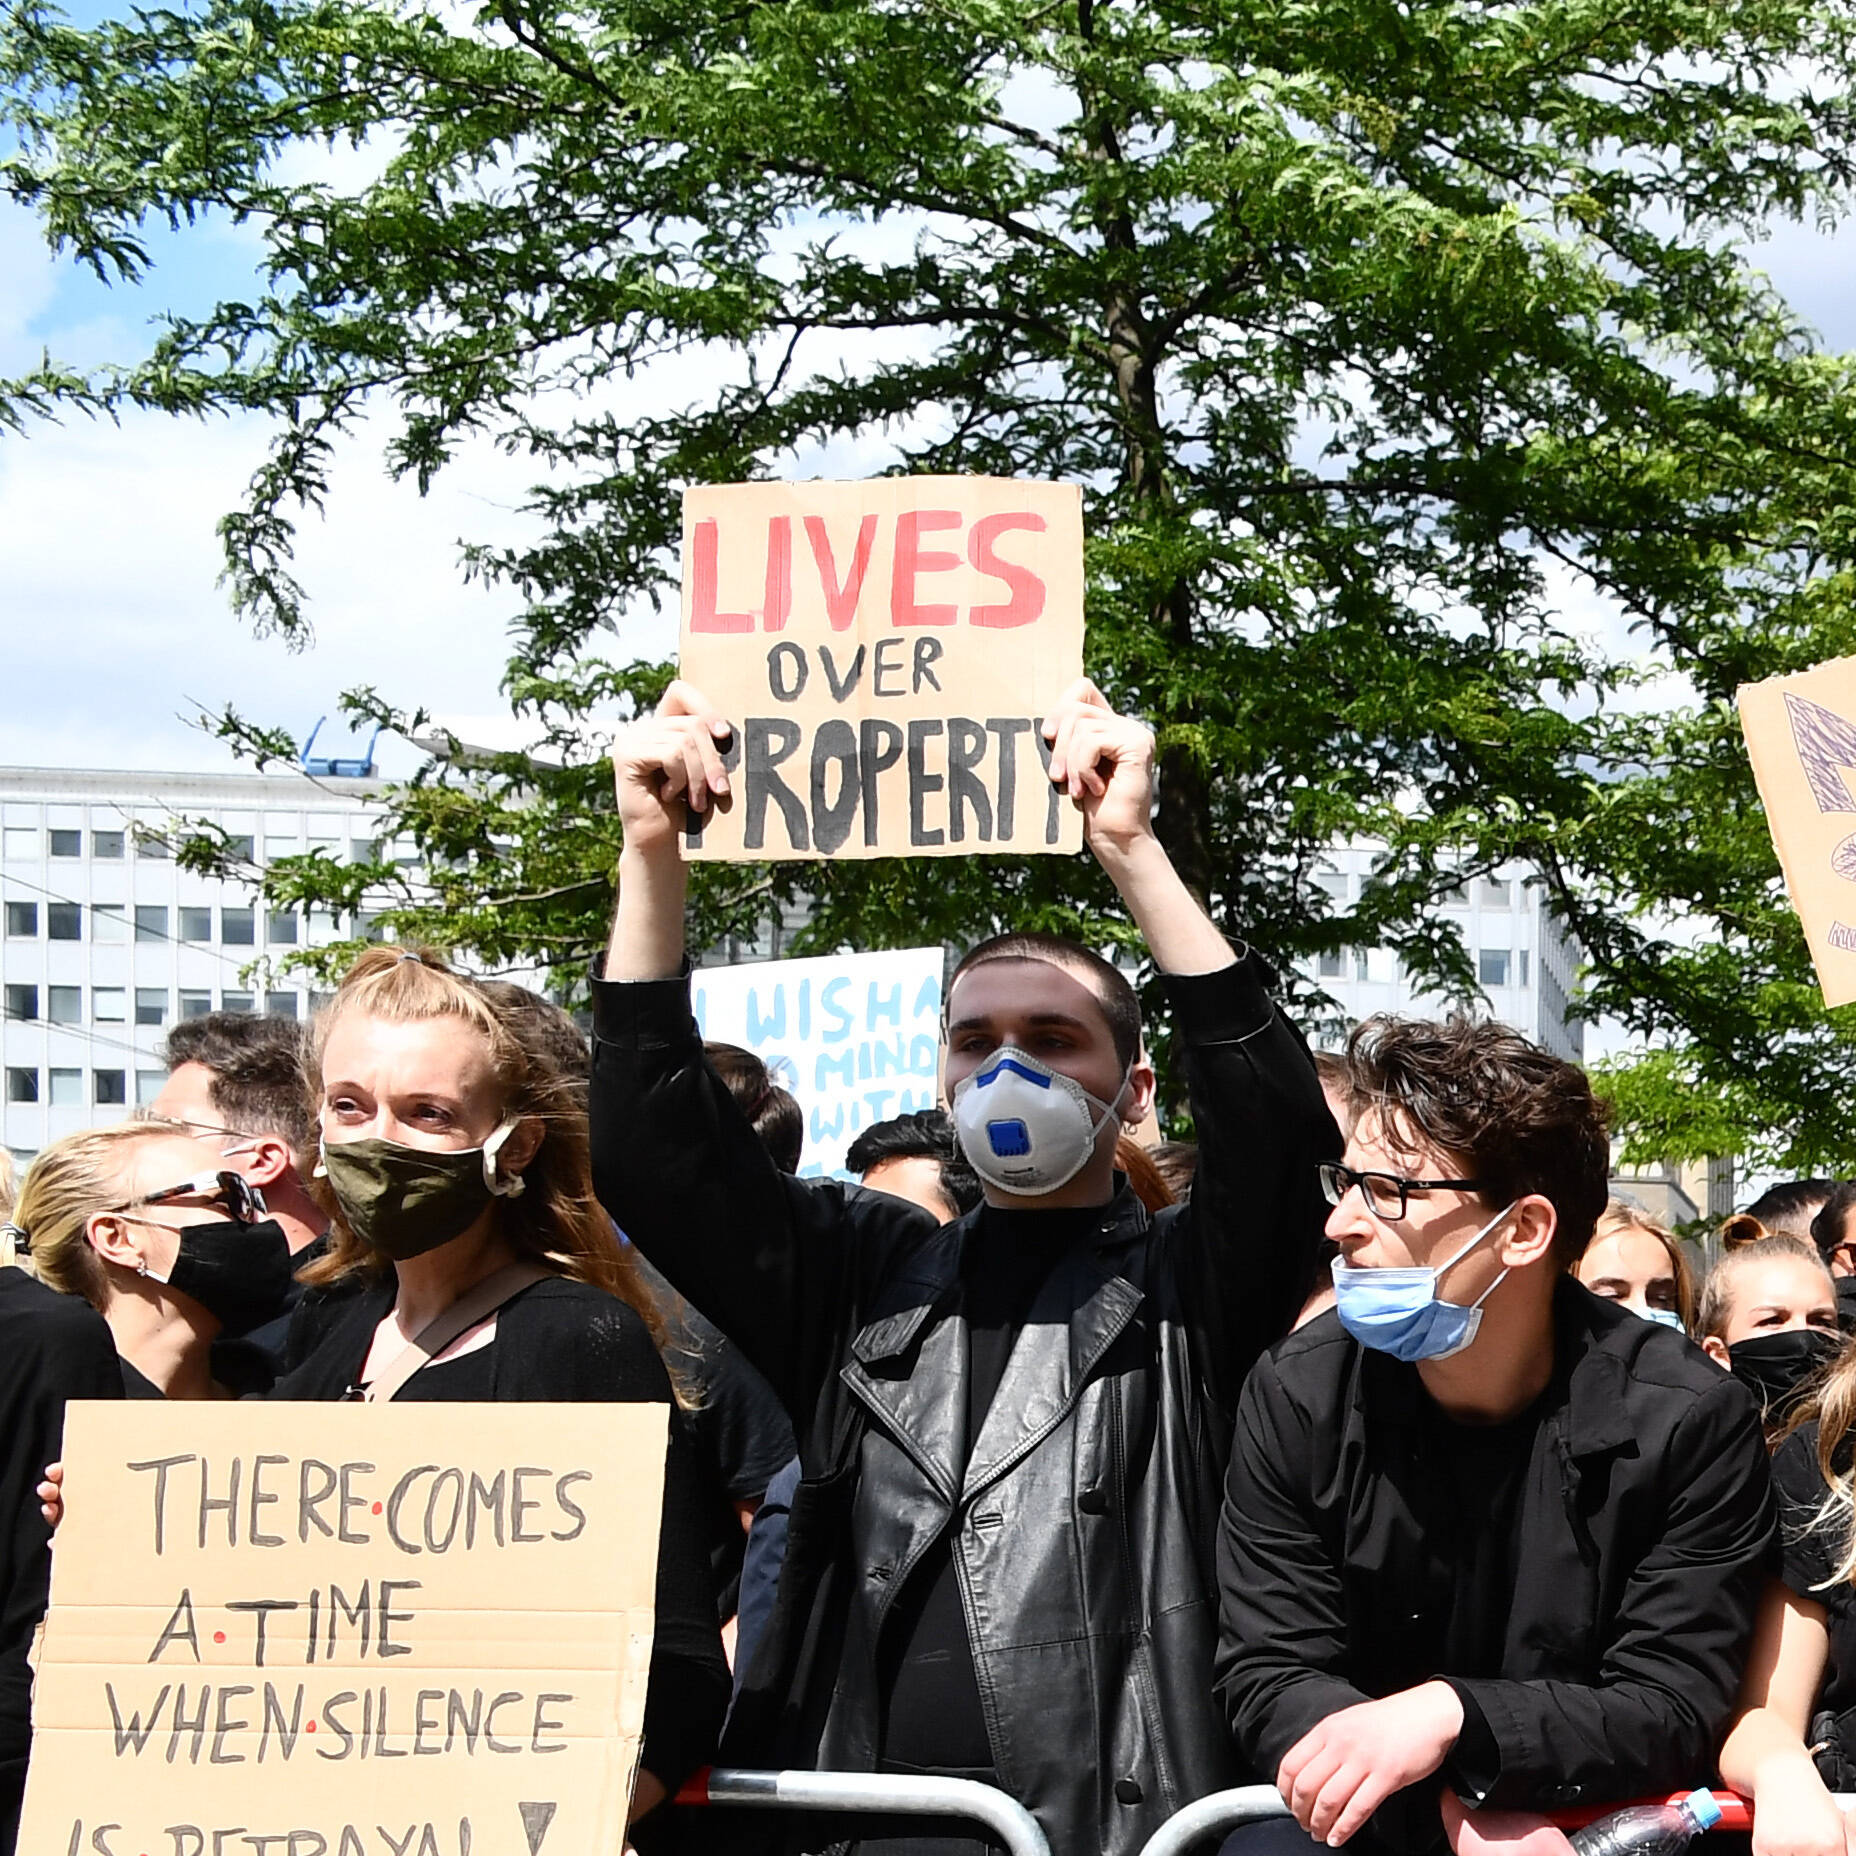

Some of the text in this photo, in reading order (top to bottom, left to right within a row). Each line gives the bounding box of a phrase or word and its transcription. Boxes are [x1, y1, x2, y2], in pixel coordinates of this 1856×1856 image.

[690, 510, 1048, 633] LIVES
[767, 637, 943, 703] OVER
[746, 976, 902, 1048] WISH
[815, 1032, 937, 1091] MIND
[148, 1579, 423, 1667] A TIME
[105, 1682, 579, 1764] WHEN SILENCE
